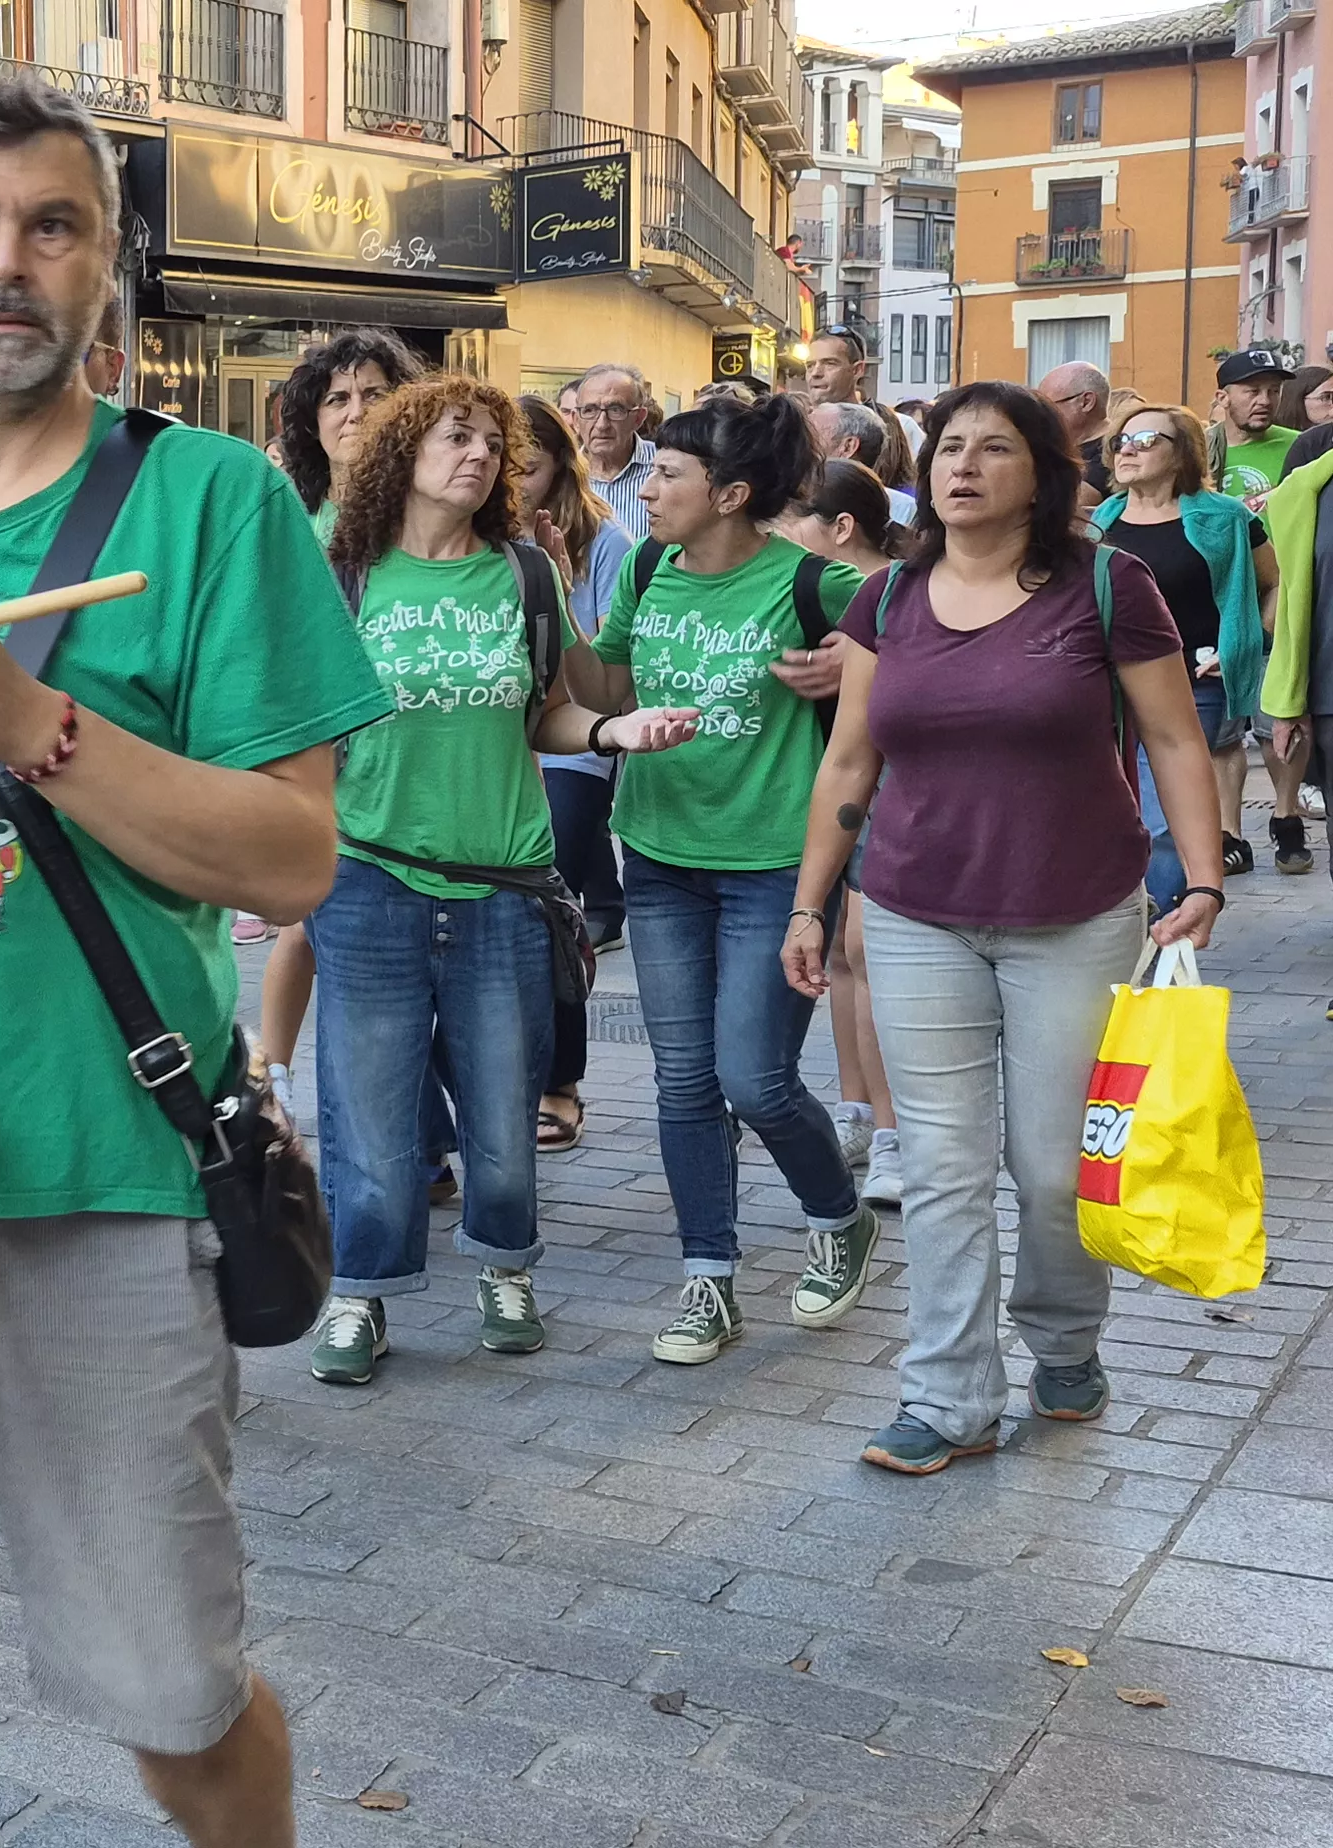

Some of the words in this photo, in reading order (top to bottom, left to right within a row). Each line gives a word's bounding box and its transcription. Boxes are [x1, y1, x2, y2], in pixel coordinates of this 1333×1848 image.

[270, 160, 384, 235] Génesis
[631, 614, 688, 644] CUELA
[693, 621, 779, 655] PÚBLICA:
[375, 656, 412, 675] DE
[428, 650, 523, 671] TOD@S
[395, 686, 441, 712] RA
[633, 665, 644, 685] E
[656, 669, 748, 698] TOD@S
[1083, 1106, 1135, 1157] EGO
